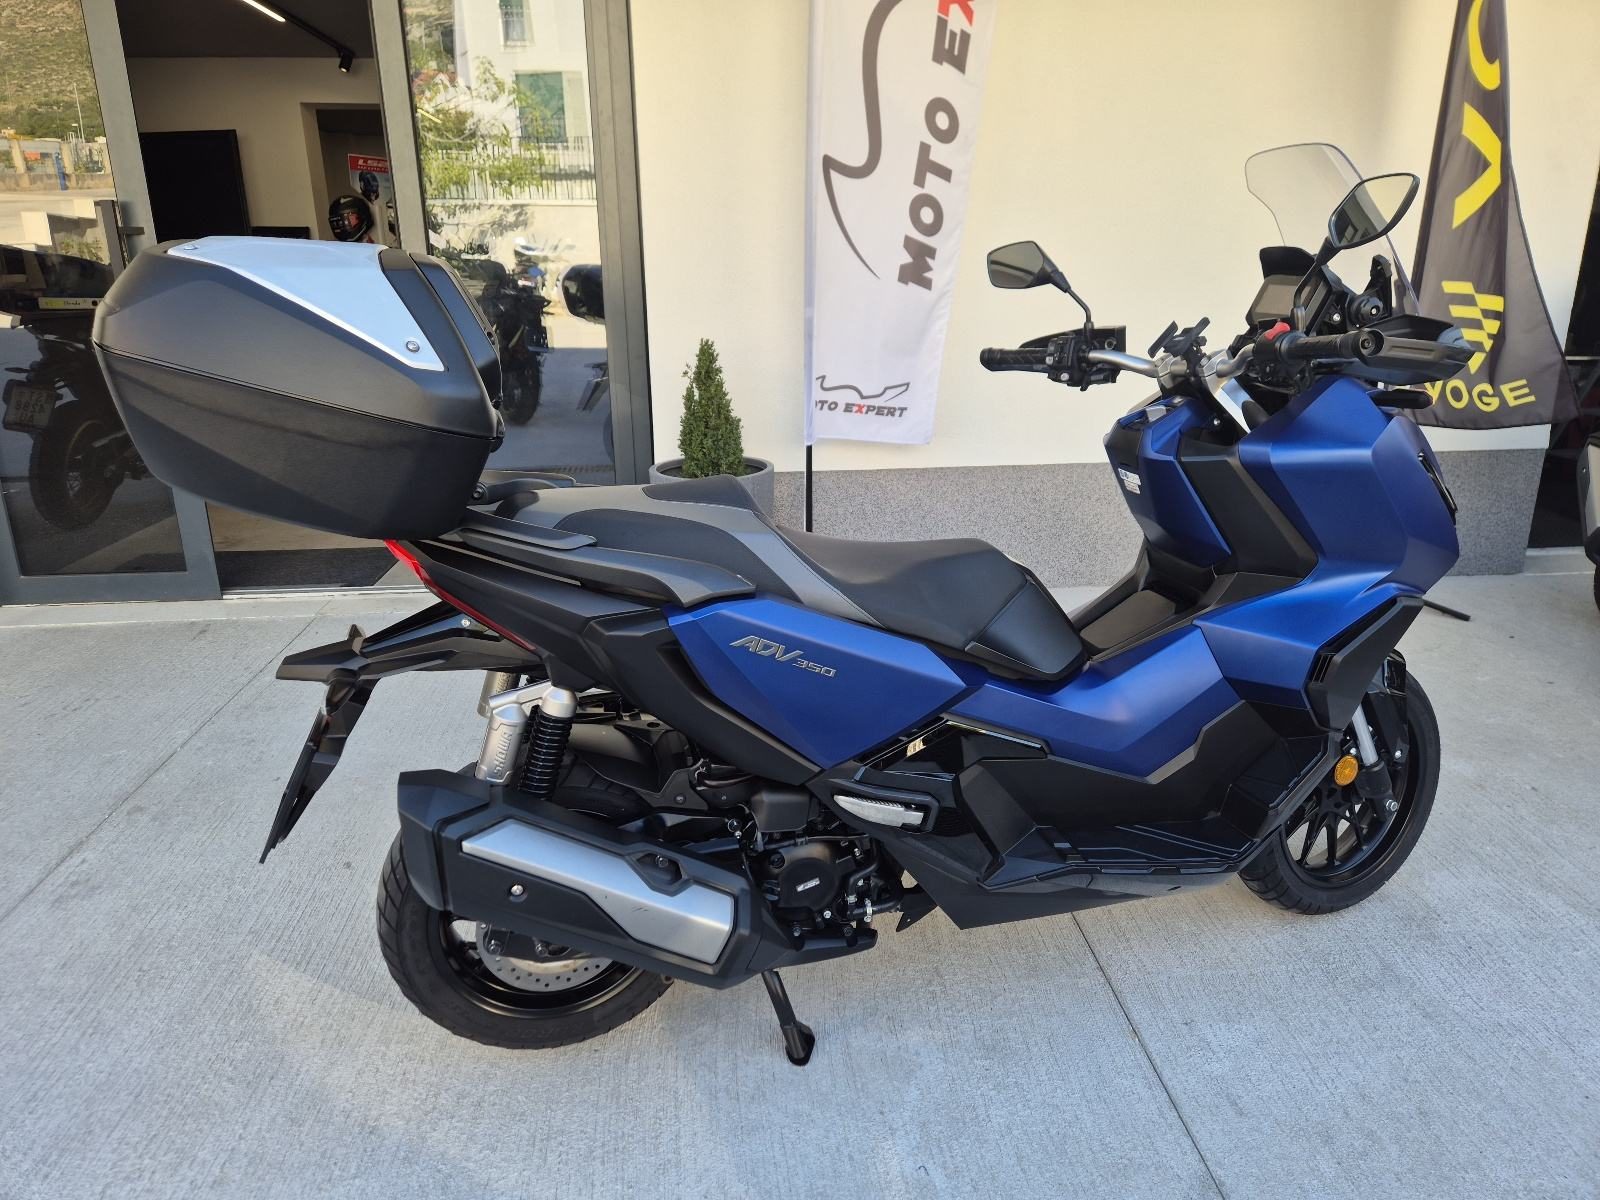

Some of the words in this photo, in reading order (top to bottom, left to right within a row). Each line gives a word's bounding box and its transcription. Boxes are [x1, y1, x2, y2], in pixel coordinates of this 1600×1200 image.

[897, 96, 959, 291] MOTO
[815, 400, 838, 411] TO
[843, 403, 908, 418] EXPERT
[729, 635, 804, 662] ADV
[792, 658, 836, 677] 350
